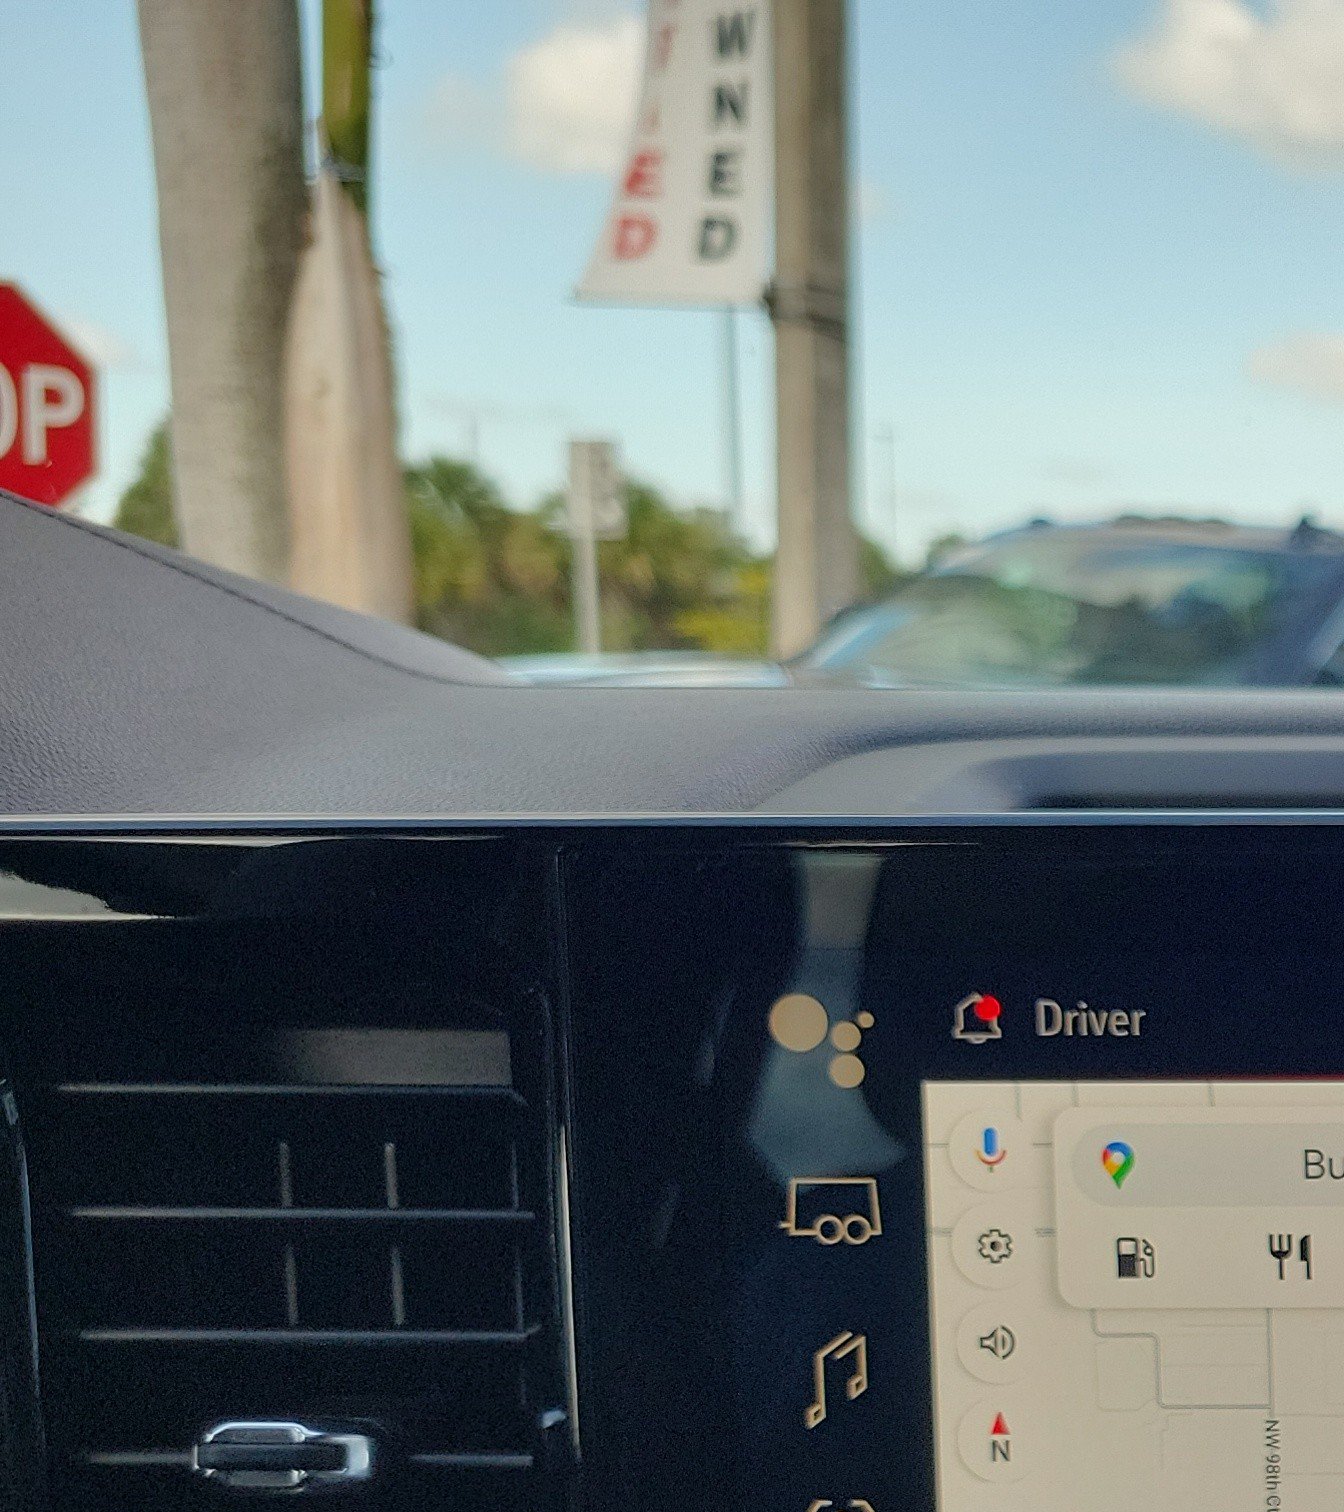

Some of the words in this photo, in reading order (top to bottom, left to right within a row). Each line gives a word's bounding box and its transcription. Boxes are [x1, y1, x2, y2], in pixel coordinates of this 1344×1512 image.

[0, 361, 85, 466] P
[1035, 999, 1146, 1039] Driver
[991, 1440, 1011, 1461] N
[1265, 1420, 1281, 1449] NW
[1265, 1454, 1281, 1490] 98th
[1266, 1495, 1281, 1512] Ct
